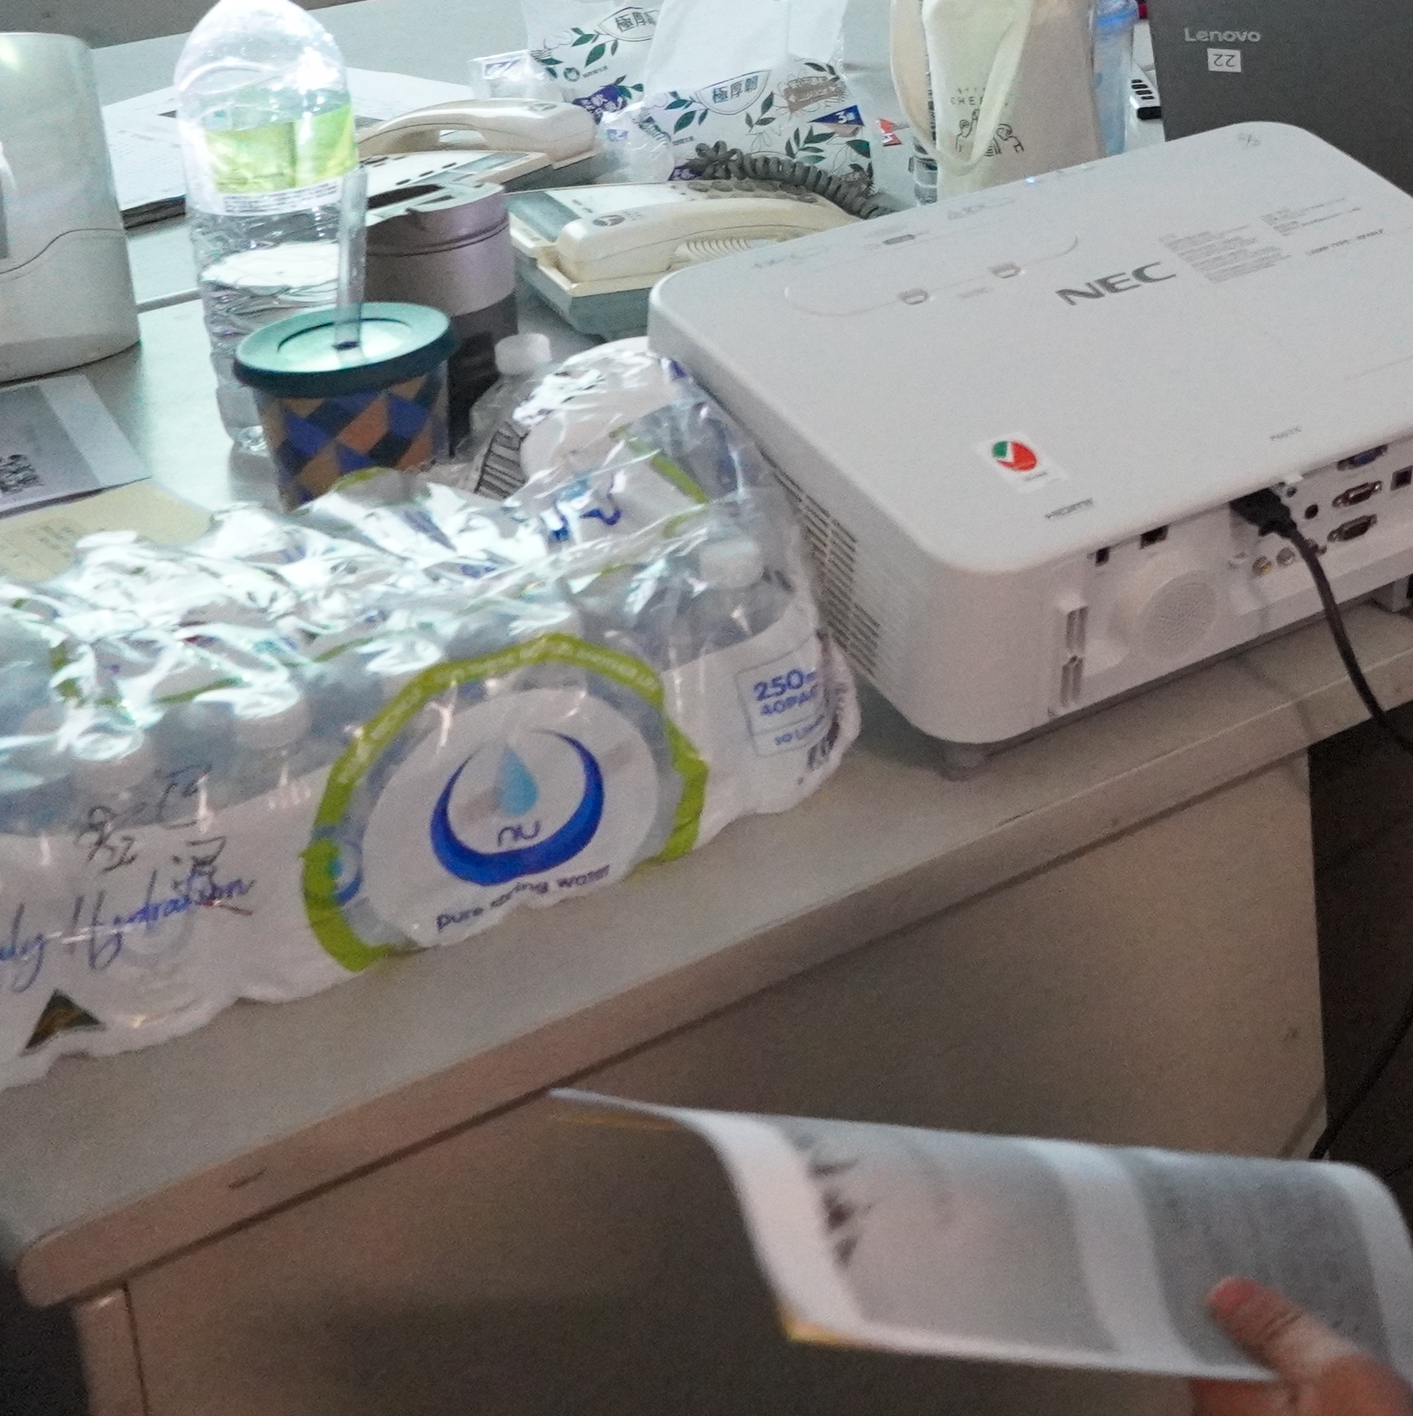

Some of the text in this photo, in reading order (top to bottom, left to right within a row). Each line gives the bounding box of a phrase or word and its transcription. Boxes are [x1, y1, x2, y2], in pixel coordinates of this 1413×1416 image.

[1184, 27, 1261, 43] Lenovo
[1055, 261, 1177, 306] NEC
[497, 820, 541, 847] nu
[436, 907, 484, 934] pure
